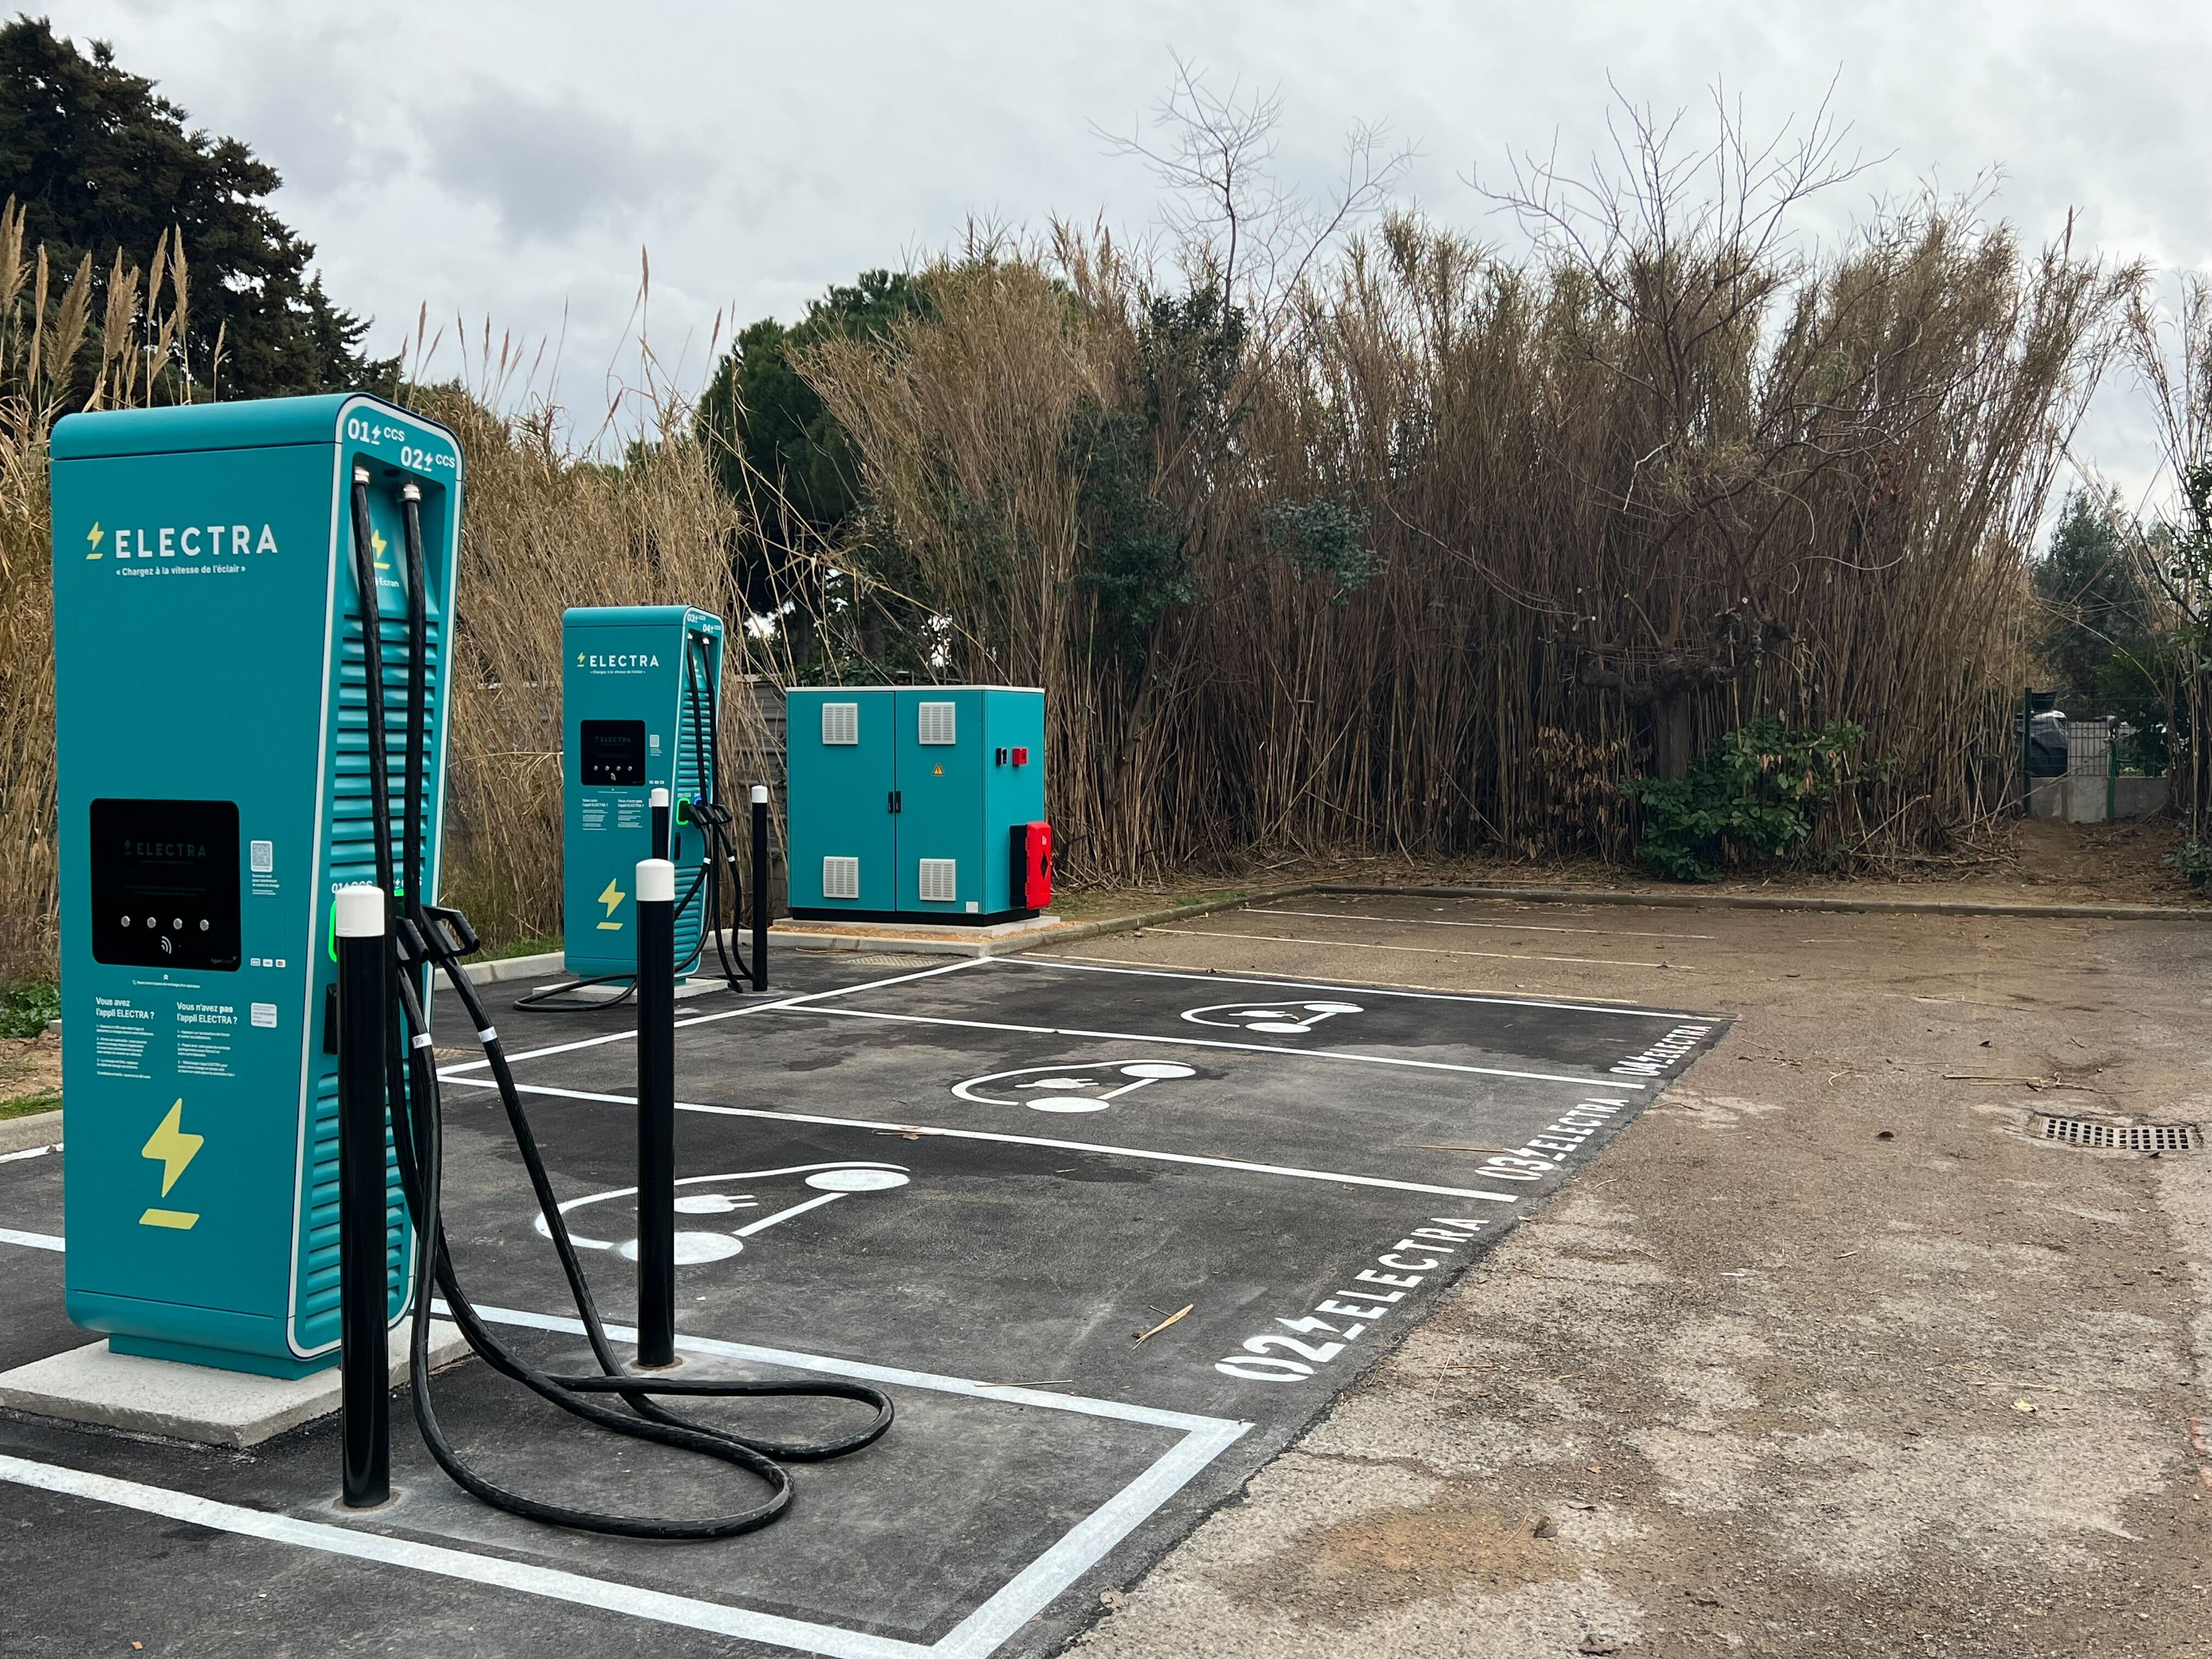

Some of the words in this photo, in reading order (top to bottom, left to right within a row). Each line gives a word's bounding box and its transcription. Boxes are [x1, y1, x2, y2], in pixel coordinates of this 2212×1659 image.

[348, 419, 369, 443] 01
[384, 427, 404, 441] CCS
[401, 446, 422, 470] 02
[435, 454, 455, 468] CCS
[116, 524, 278, 558] ELECTRA
[122, 568, 153, 577] Chargez
[155, 566, 160, 575] à
[213, 565, 239, 573] l'éclair
[379, 576, 399, 588] Écran
[590, 655, 658, 667] ELECTRA
[138, 843, 206, 856] ELECTRA
[96, 997, 113, 1006] Vous
[177, 1002, 194, 1011] Vous
[96, 1008, 115, 1018] l'appli
[117, 1009, 149, 1019] ELECTRA
[177, 1013, 197, 1023] l'appli
[199, 1014, 232, 1024] ELECTRA
[1609, 1060, 1668, 1076] 04
[1643, 1025, 1712, 1059] ELECTRA
[1475, 1156, 1554, 1181] 03
[1527, 1098, 1629, 1152] ELECTRA
[1215, 1335, 1347, 1382] 02
[1314, 1217, 1490, 1319] ELECTRA
